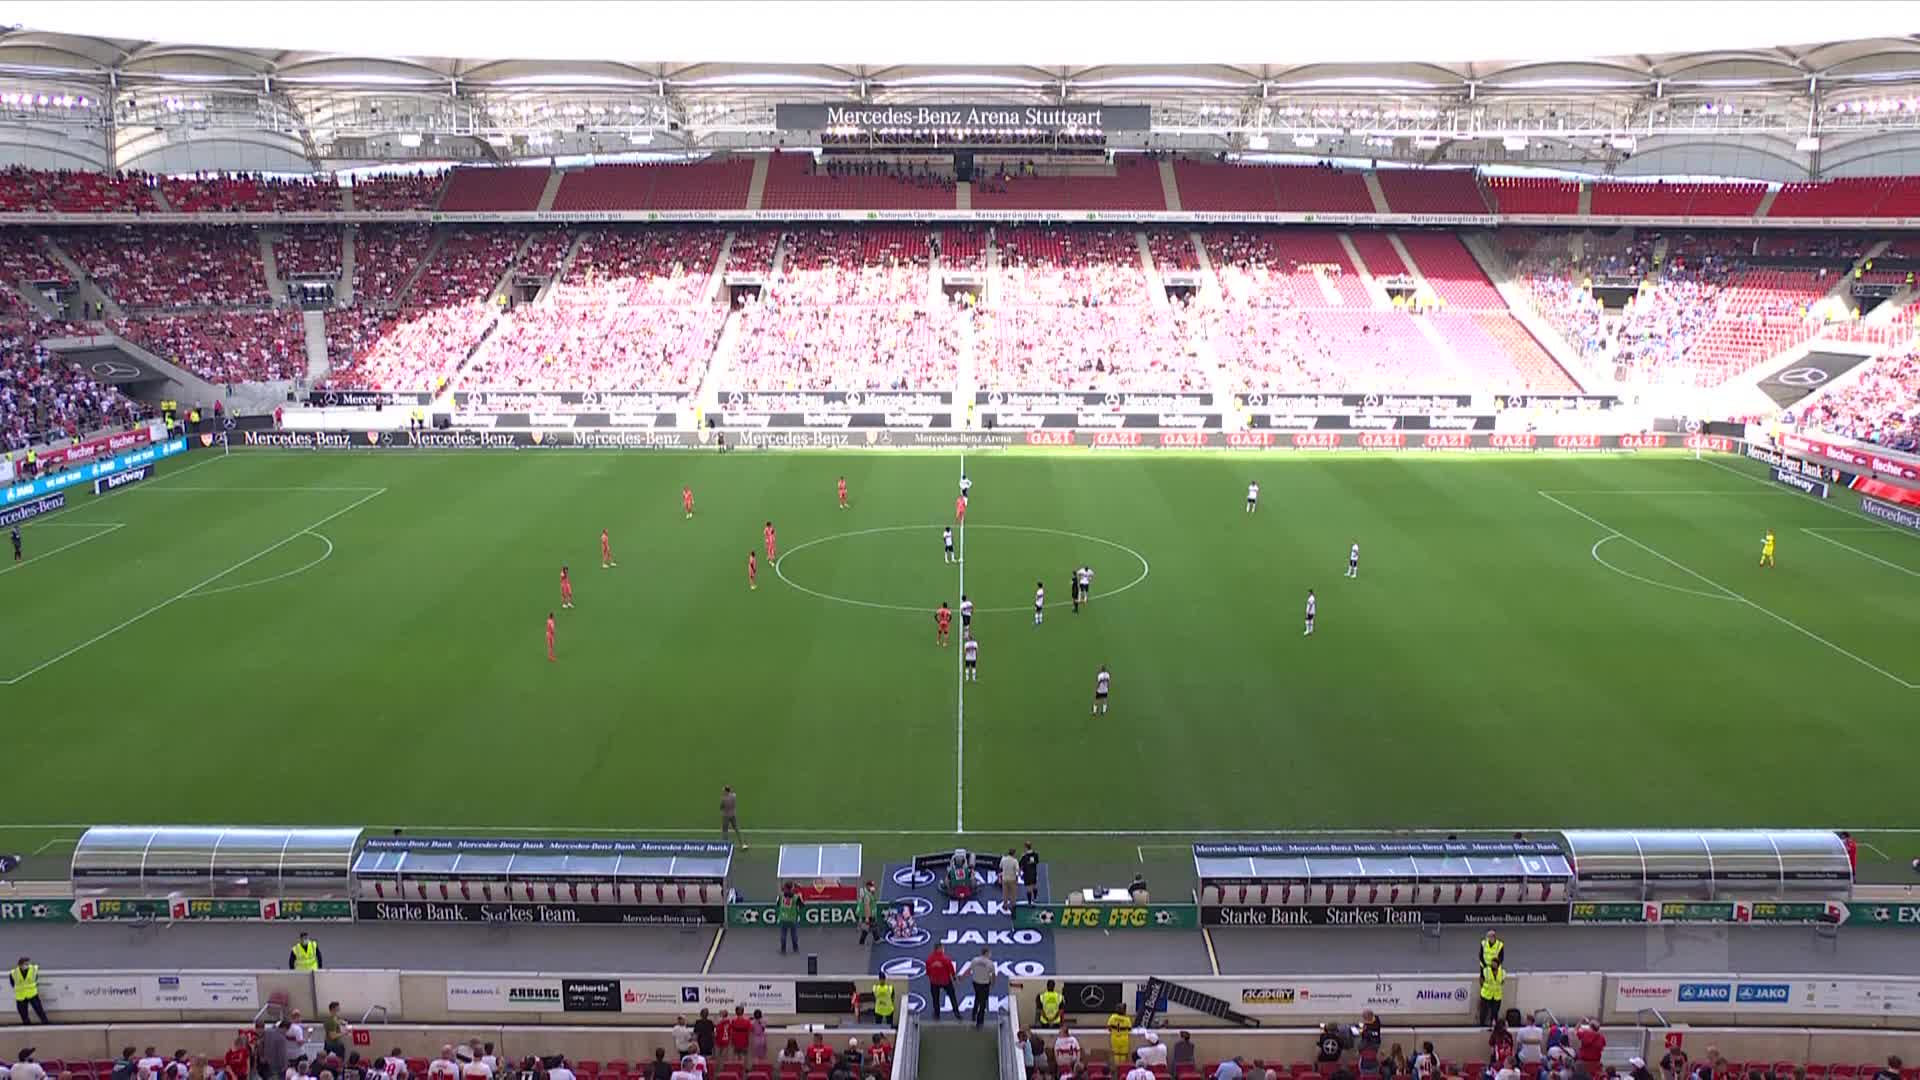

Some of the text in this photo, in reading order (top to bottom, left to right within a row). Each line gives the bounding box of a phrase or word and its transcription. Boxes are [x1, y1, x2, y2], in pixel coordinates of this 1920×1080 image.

[828, 107, 1101, 129] Mercedes-Benz Arena Stuttgart
[244, 431, 350, 445] Mercedes-Benz
[408, 432, 514, 445] Mercedes-Benz
[573, 432, 680, 445] Mercedes-Benz
[740, 432, 848, 445] Mercedes-Benz
[914, 433, 1012, 443] Mercedes-Benz Arena
[67, 446, 94, 461] fischer
[1747, 443, 1801, 473] Mercedes-Benz
[1802, 460, 1823, 478] Bank
[1827, 446, 1854, 463] fischer
[1872, 458, 1903, 476] fischer
[108, 468, 145, 489] betway
[1778, 469, 1814, 493] betway
[376, 903, 469, 922] Starke Bank.
[480, 904, 580, 923] Starkes Team.
[1061, 907, 1099, 928] ITC
[1108, 907, 1148, 928] ITC
[1220, 906, 1313, 925] Starke Bank.
[1326, 907, 1380, 925] Starkes
[1464, 914, 1547, 923] Mercedes-Benz Bank
[940, 930, 1042, 944] JAKO
[1376, 983, 1393, 993] RTS
[1416, 987, 1452, 1000] Allianz
[1696, 988, 1728, 998] JAKO
[1755, 988, 1786, 998] JAKO
[356, 1032, 368, 1043] 10
